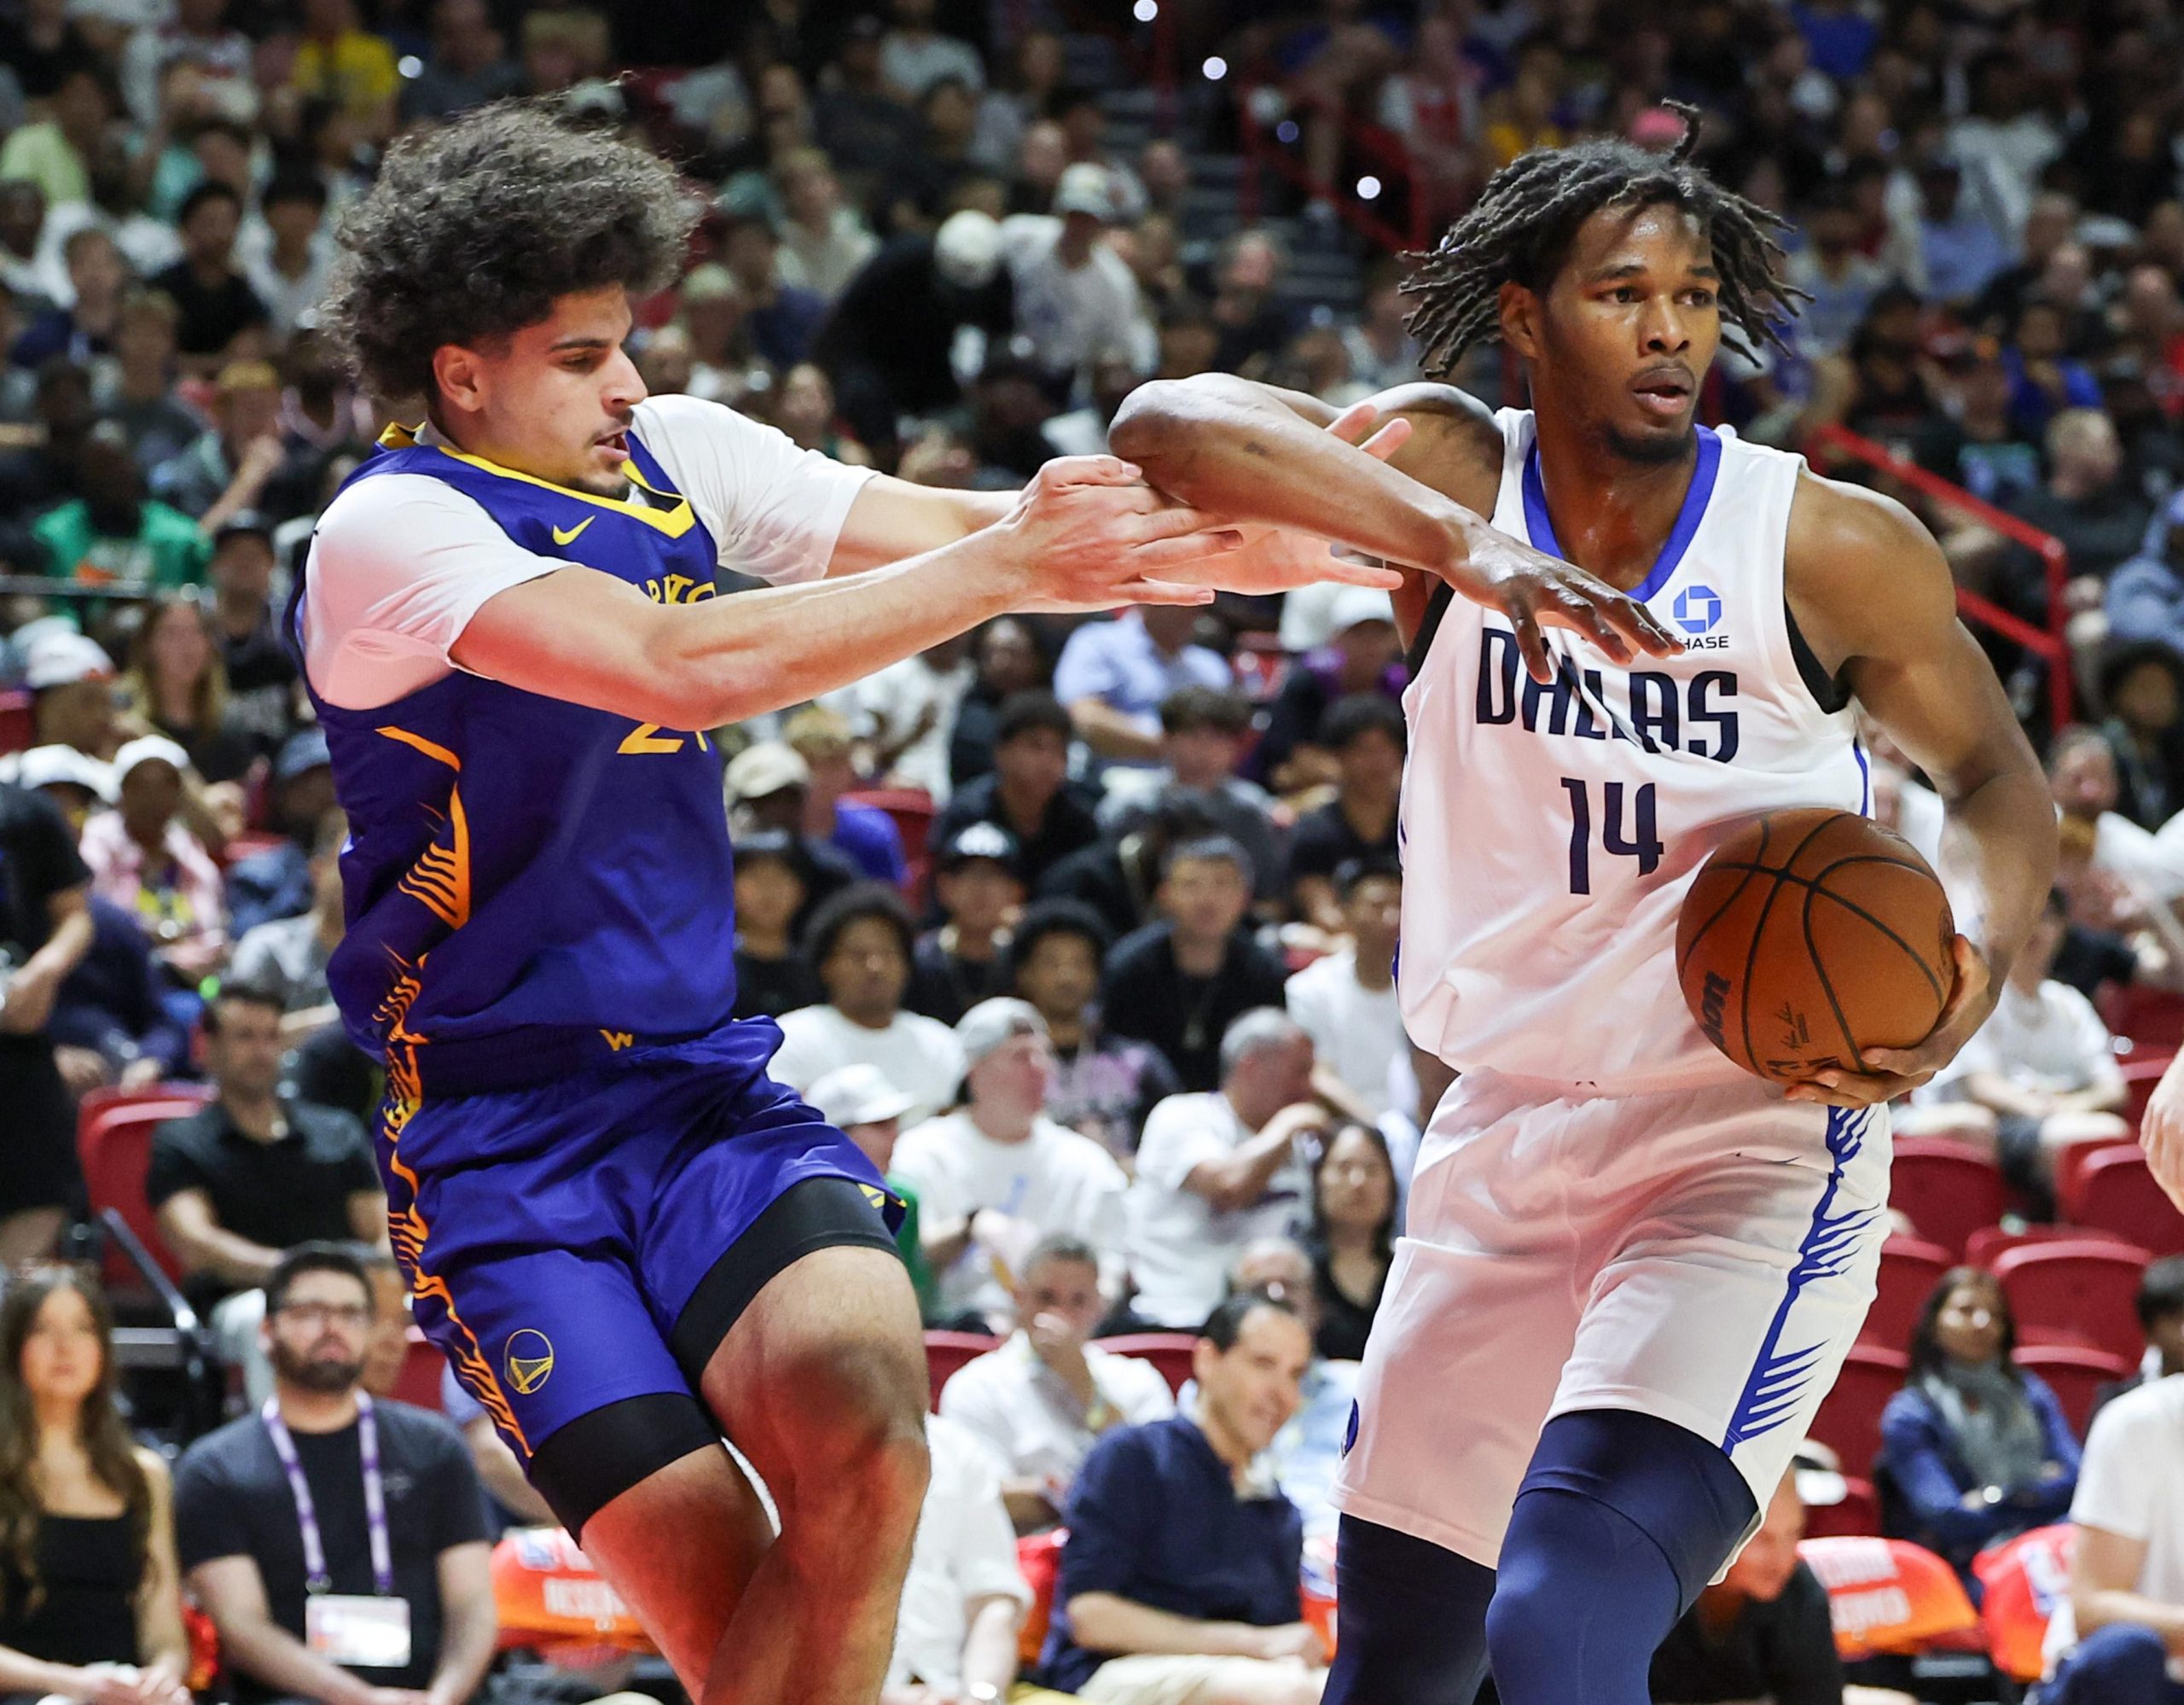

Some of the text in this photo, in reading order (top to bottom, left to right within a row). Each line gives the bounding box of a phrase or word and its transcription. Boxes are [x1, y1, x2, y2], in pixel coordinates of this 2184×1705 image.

[1476, 627, 1740, 763] DALLAS
[1679, 635, 1729, 650] HASE
[1560, 777, 1664, 894] 14
